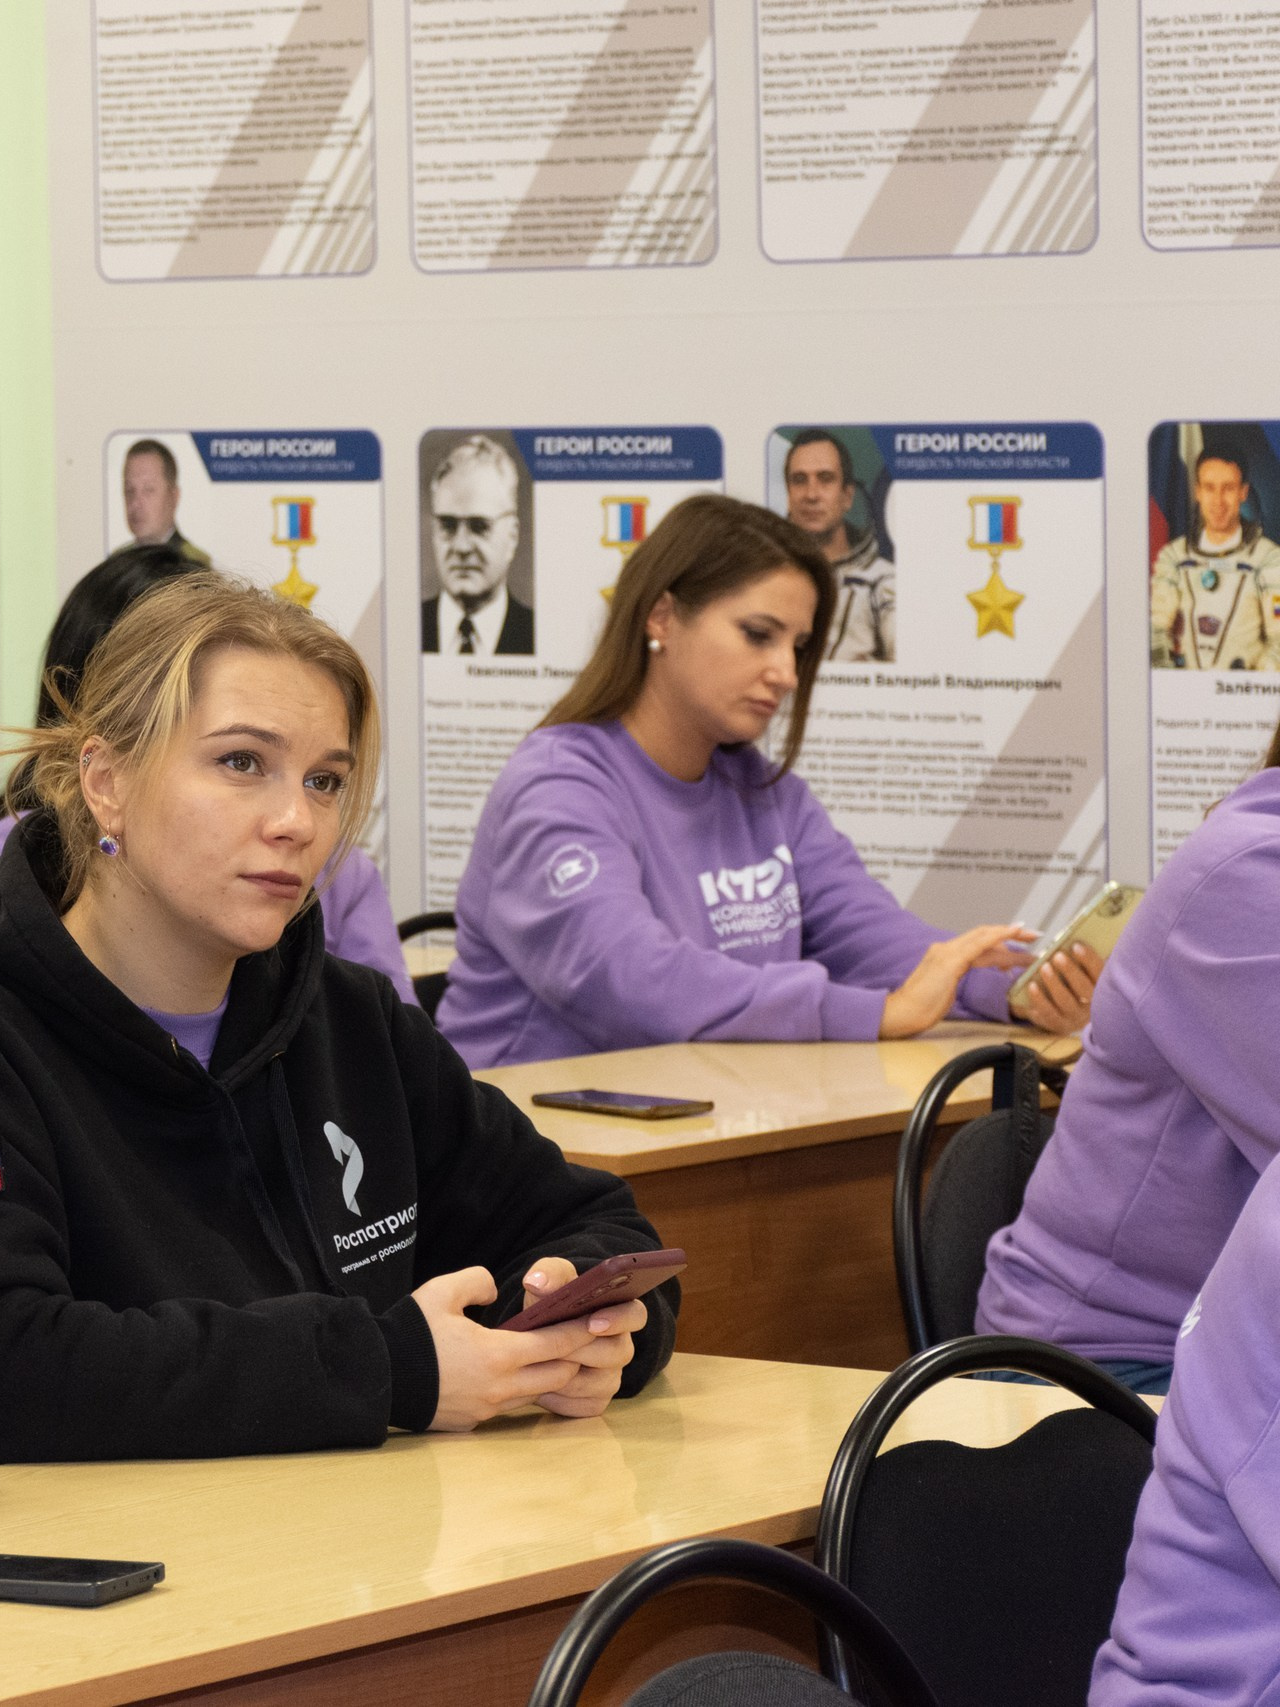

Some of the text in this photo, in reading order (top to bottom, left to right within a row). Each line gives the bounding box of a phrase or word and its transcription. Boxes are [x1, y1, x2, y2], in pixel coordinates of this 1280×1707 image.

[210, 438, 337, 457] ГЕРОИ РОССИИ
[533, 435, 673, 455] ГЕРОИ РОССИИ
[894, 432, 1047, 452] ГЕРОИ РОССИИ
[944, 675, 1063, 691] Владимирович
[341, 1257, 371, 1274] программа
[370, 1254, 378, 1262] от
